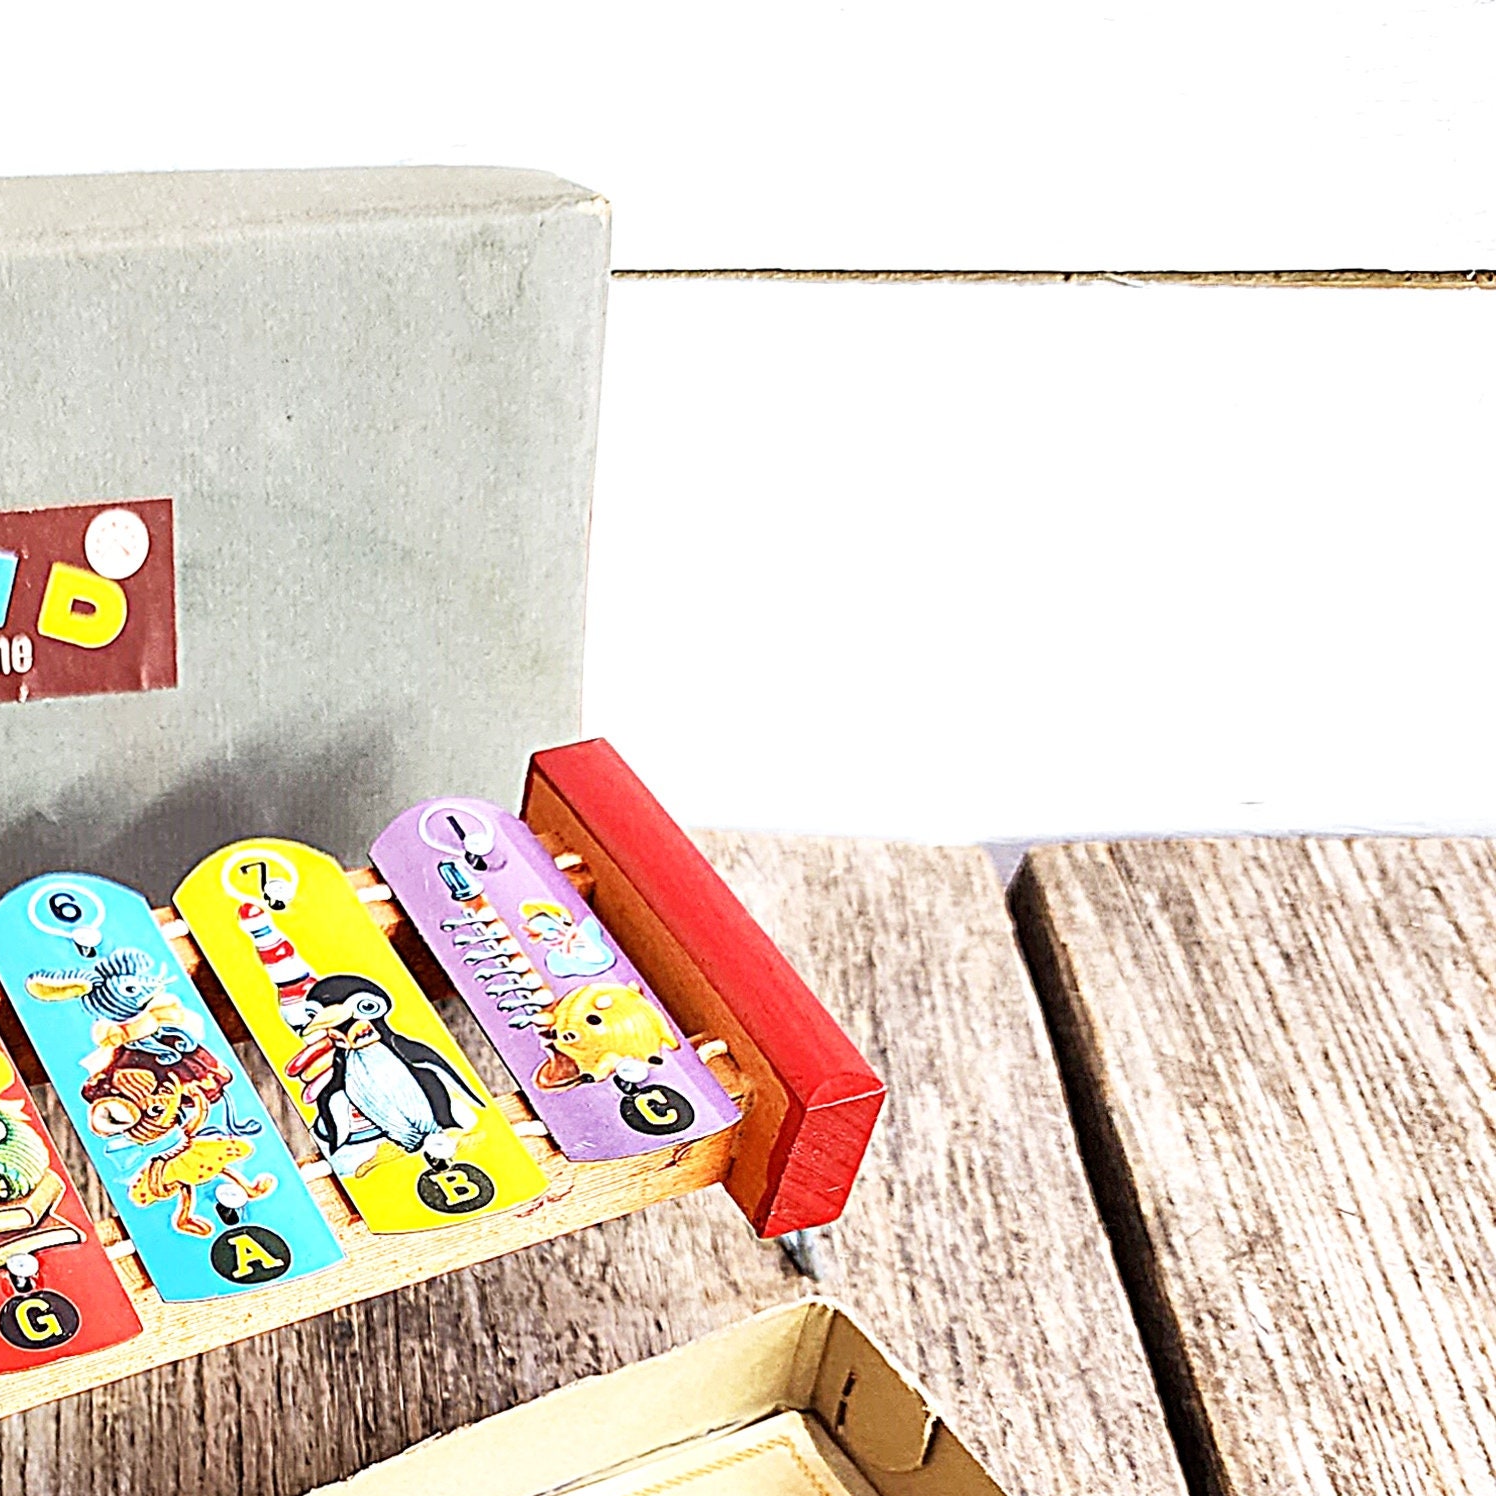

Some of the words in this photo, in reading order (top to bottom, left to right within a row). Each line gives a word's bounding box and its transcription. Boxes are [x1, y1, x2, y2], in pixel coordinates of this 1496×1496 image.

[239, 862, 270, 897] 7
[48, 891, 79, 921] 6
[638, 1093, 679, 1130] C
[441, 1167, 479, 1204] B
[233, 1235, 286, 1278] A
[19, 1300, 60, 1341] G
